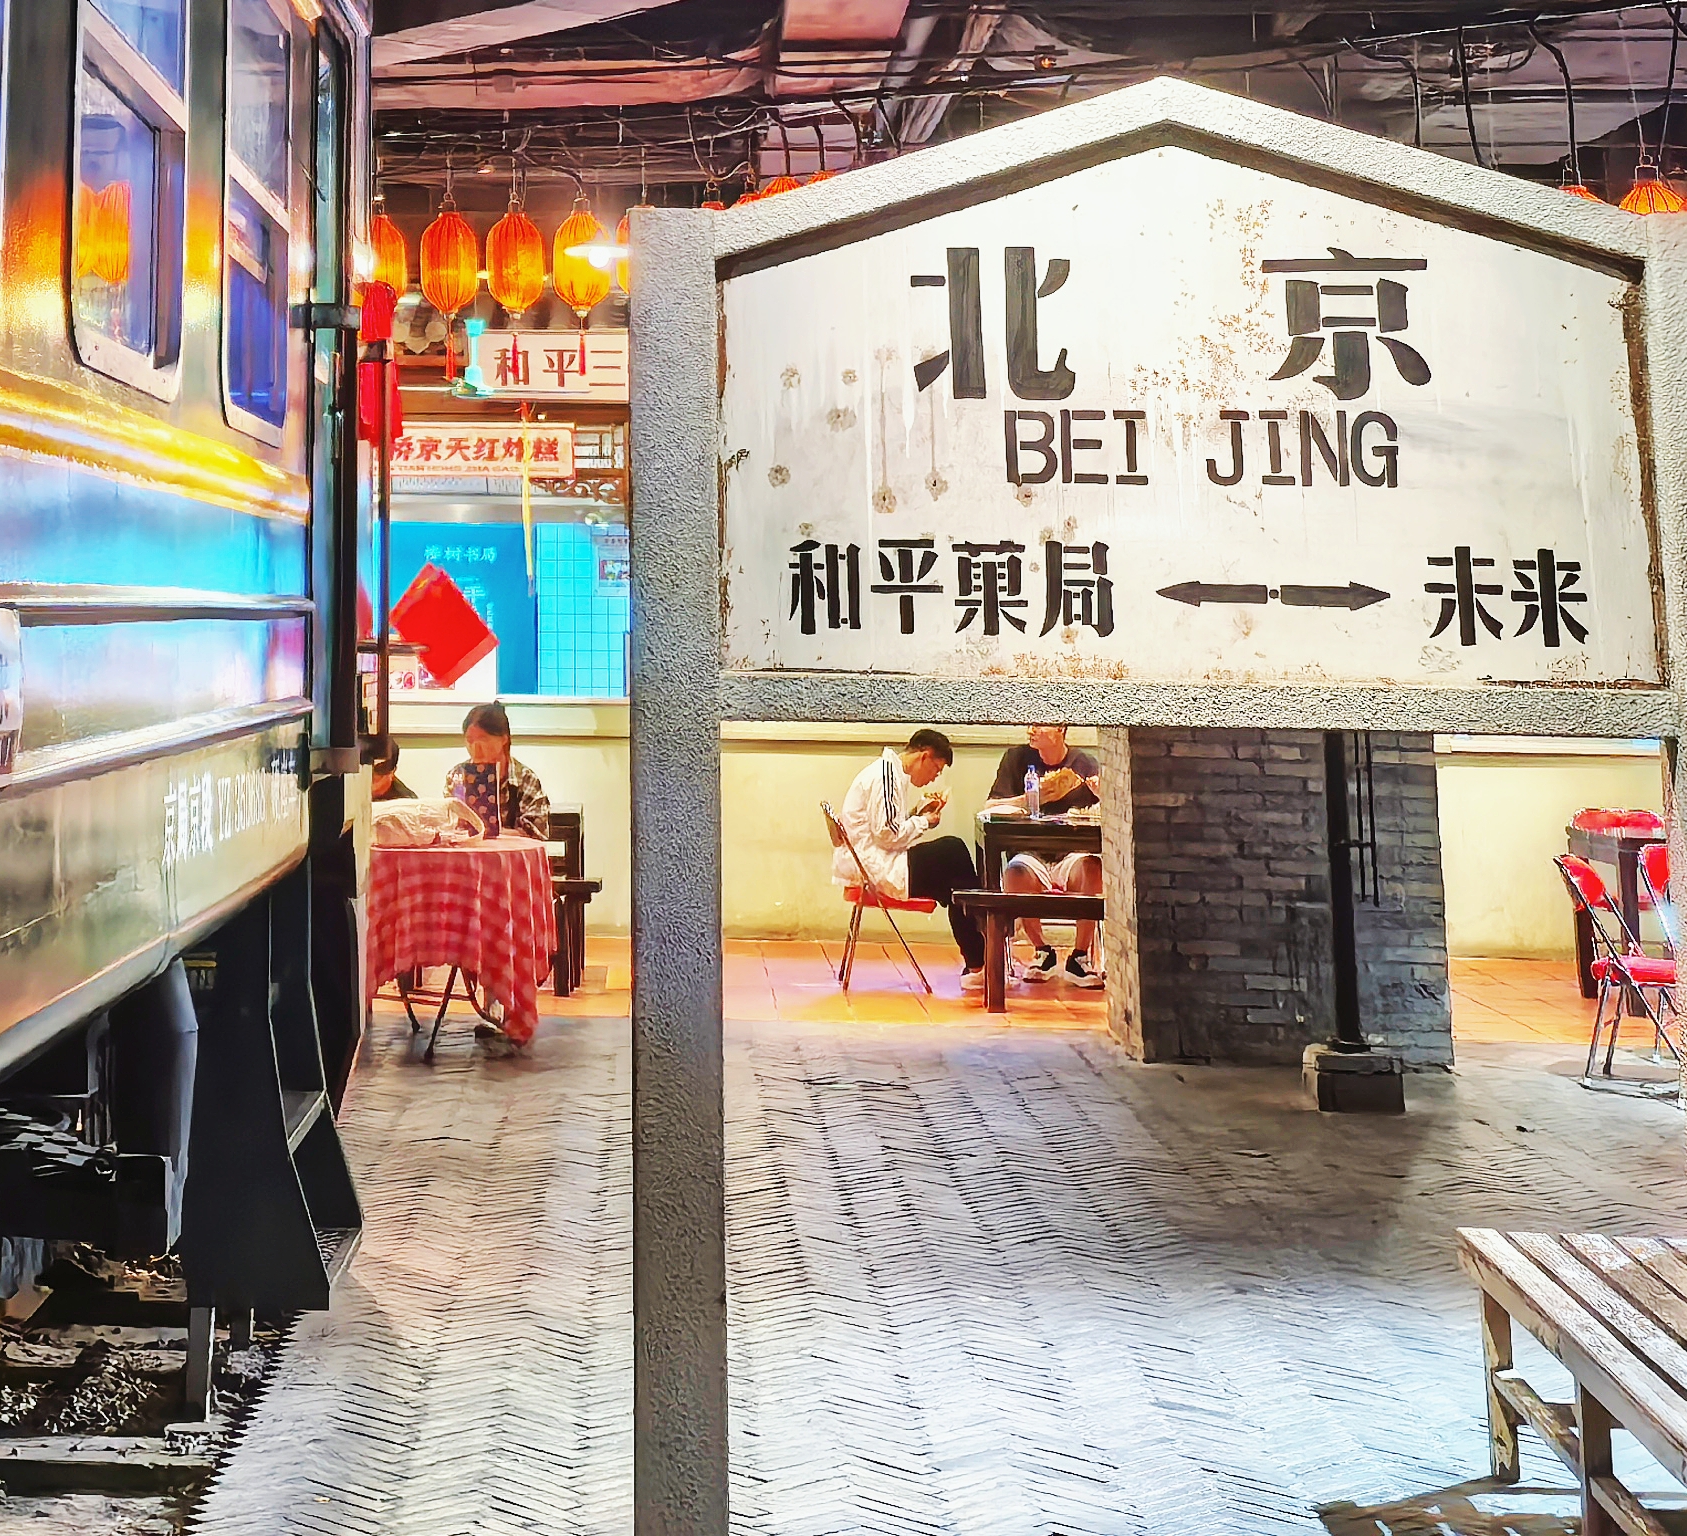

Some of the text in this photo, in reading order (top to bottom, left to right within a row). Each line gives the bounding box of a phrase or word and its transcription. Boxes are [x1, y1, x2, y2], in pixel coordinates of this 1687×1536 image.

[911, 247, 1431, 400] 北京
[1005, 408, 1398, 488] BEI JING
[789, 539, 1588, 647] 和平菓局 未来
